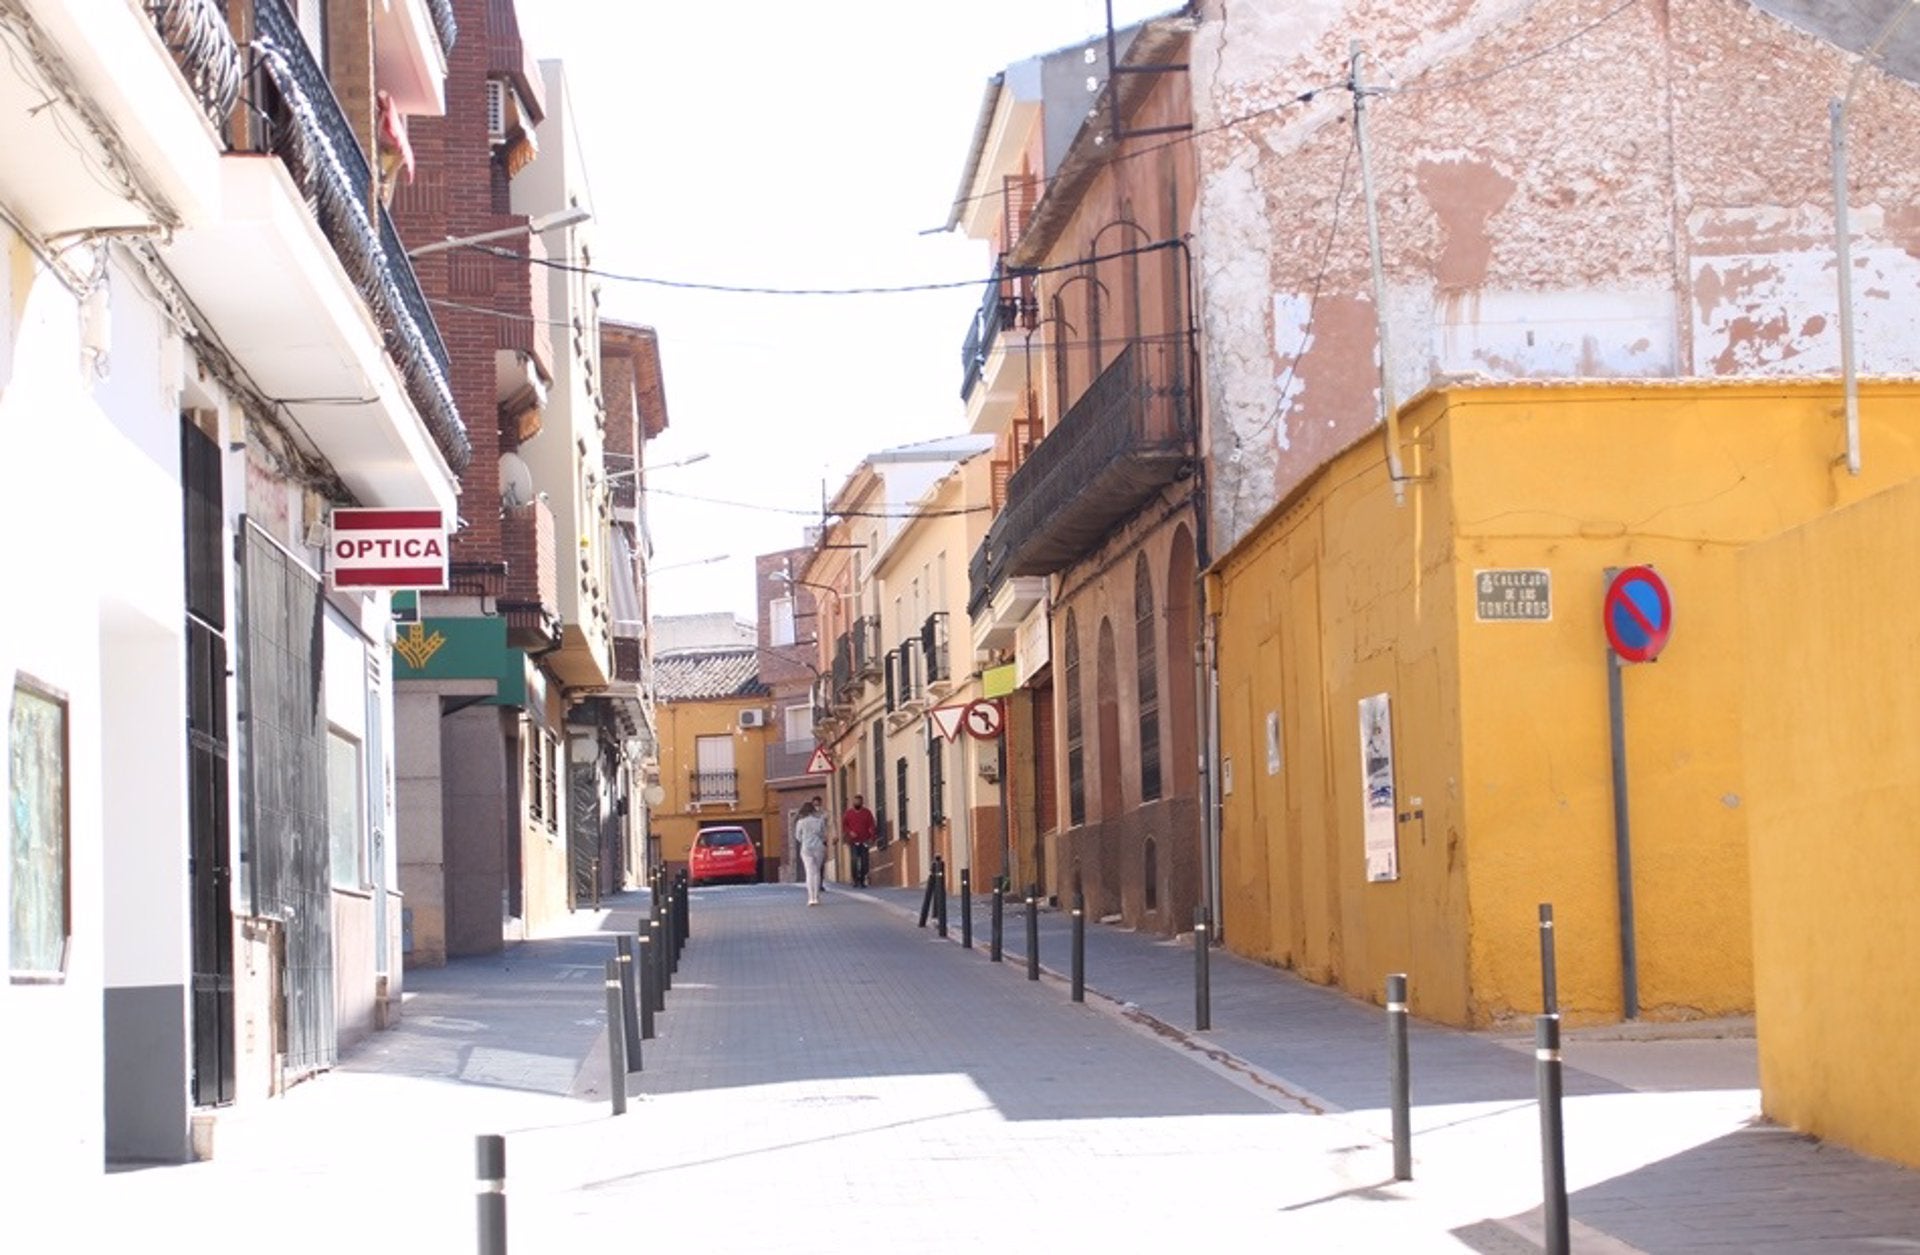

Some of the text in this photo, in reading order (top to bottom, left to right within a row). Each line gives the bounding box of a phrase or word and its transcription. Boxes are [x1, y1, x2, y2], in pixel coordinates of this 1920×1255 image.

[335, 538, 442, 559] OPTICA
[1505, 588, 1537, 600] DE LOS
[1480, 601, 1548, 616] TONELEROS
